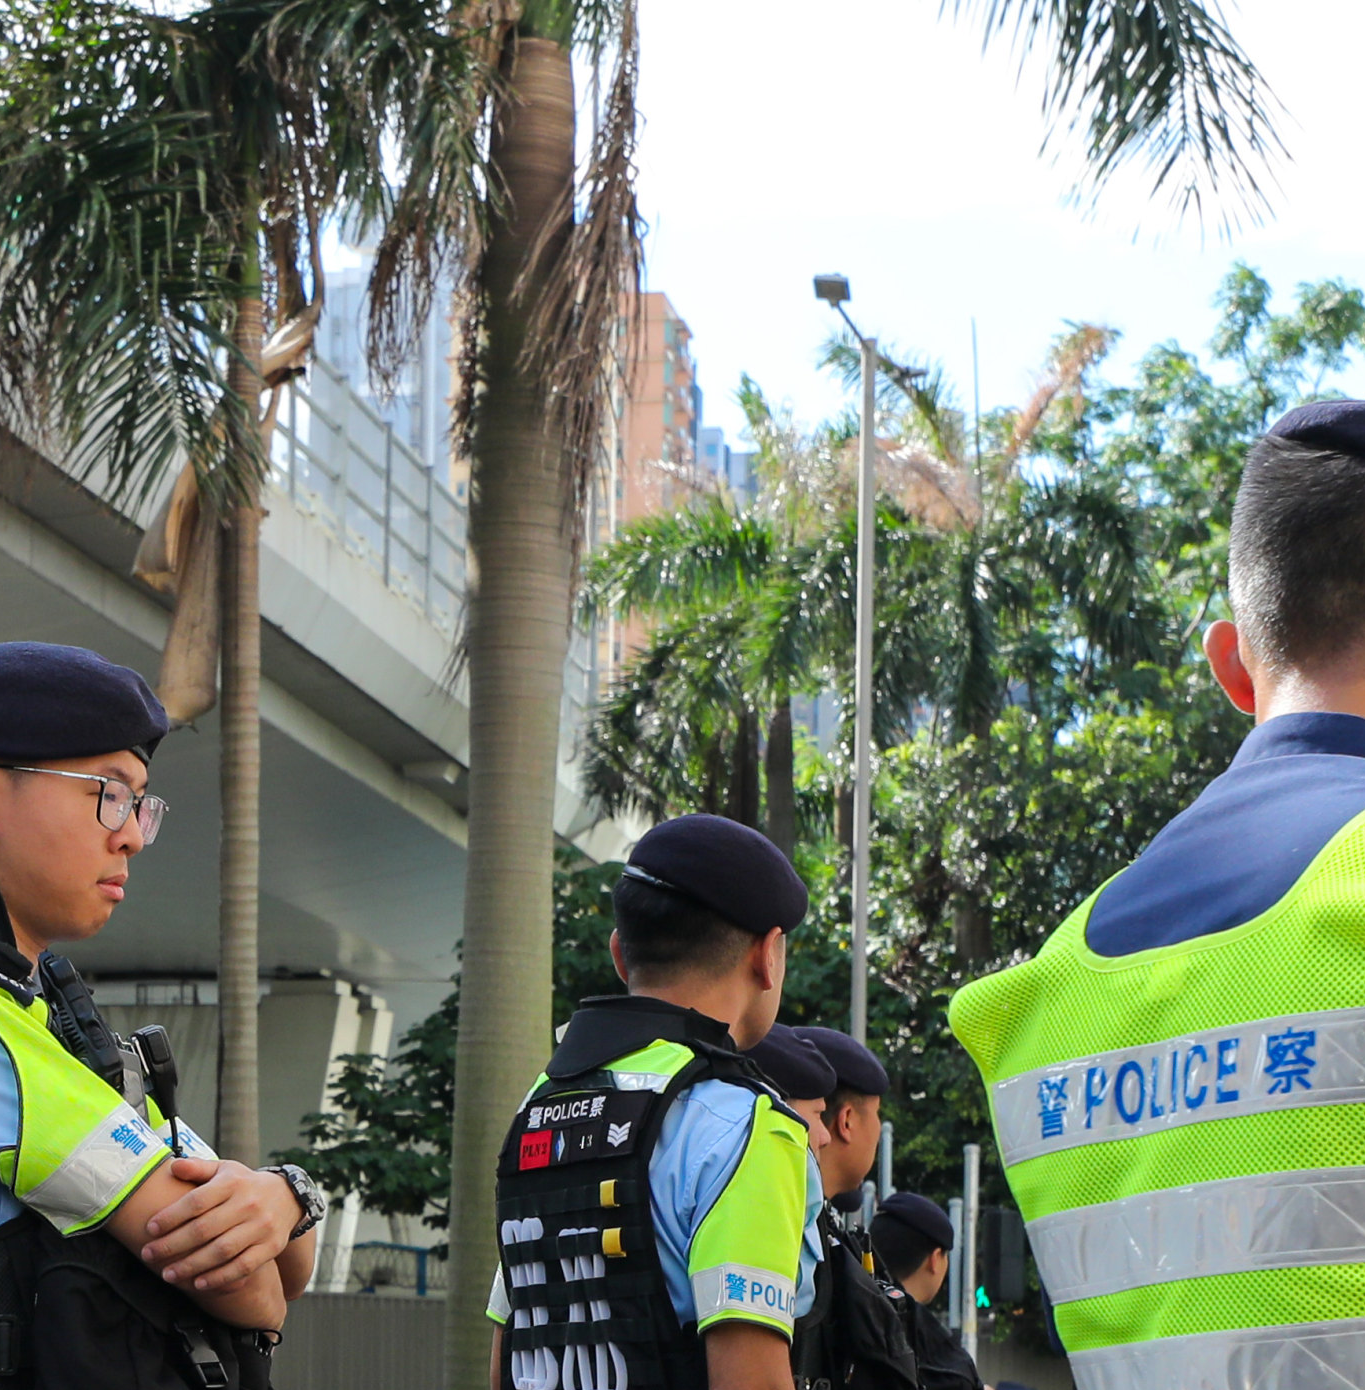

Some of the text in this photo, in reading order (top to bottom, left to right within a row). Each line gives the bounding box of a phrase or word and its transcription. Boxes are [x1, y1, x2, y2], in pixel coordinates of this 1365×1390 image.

[1037, 1027, 1317, 1139] 警 POLICE 察
[543, 1100, 591, 1125] POLICE
[589, 1095, 607, 1118] 察
[110, 1122, 148, 1156] 警
[725, 1272, 747, 1302] 警
